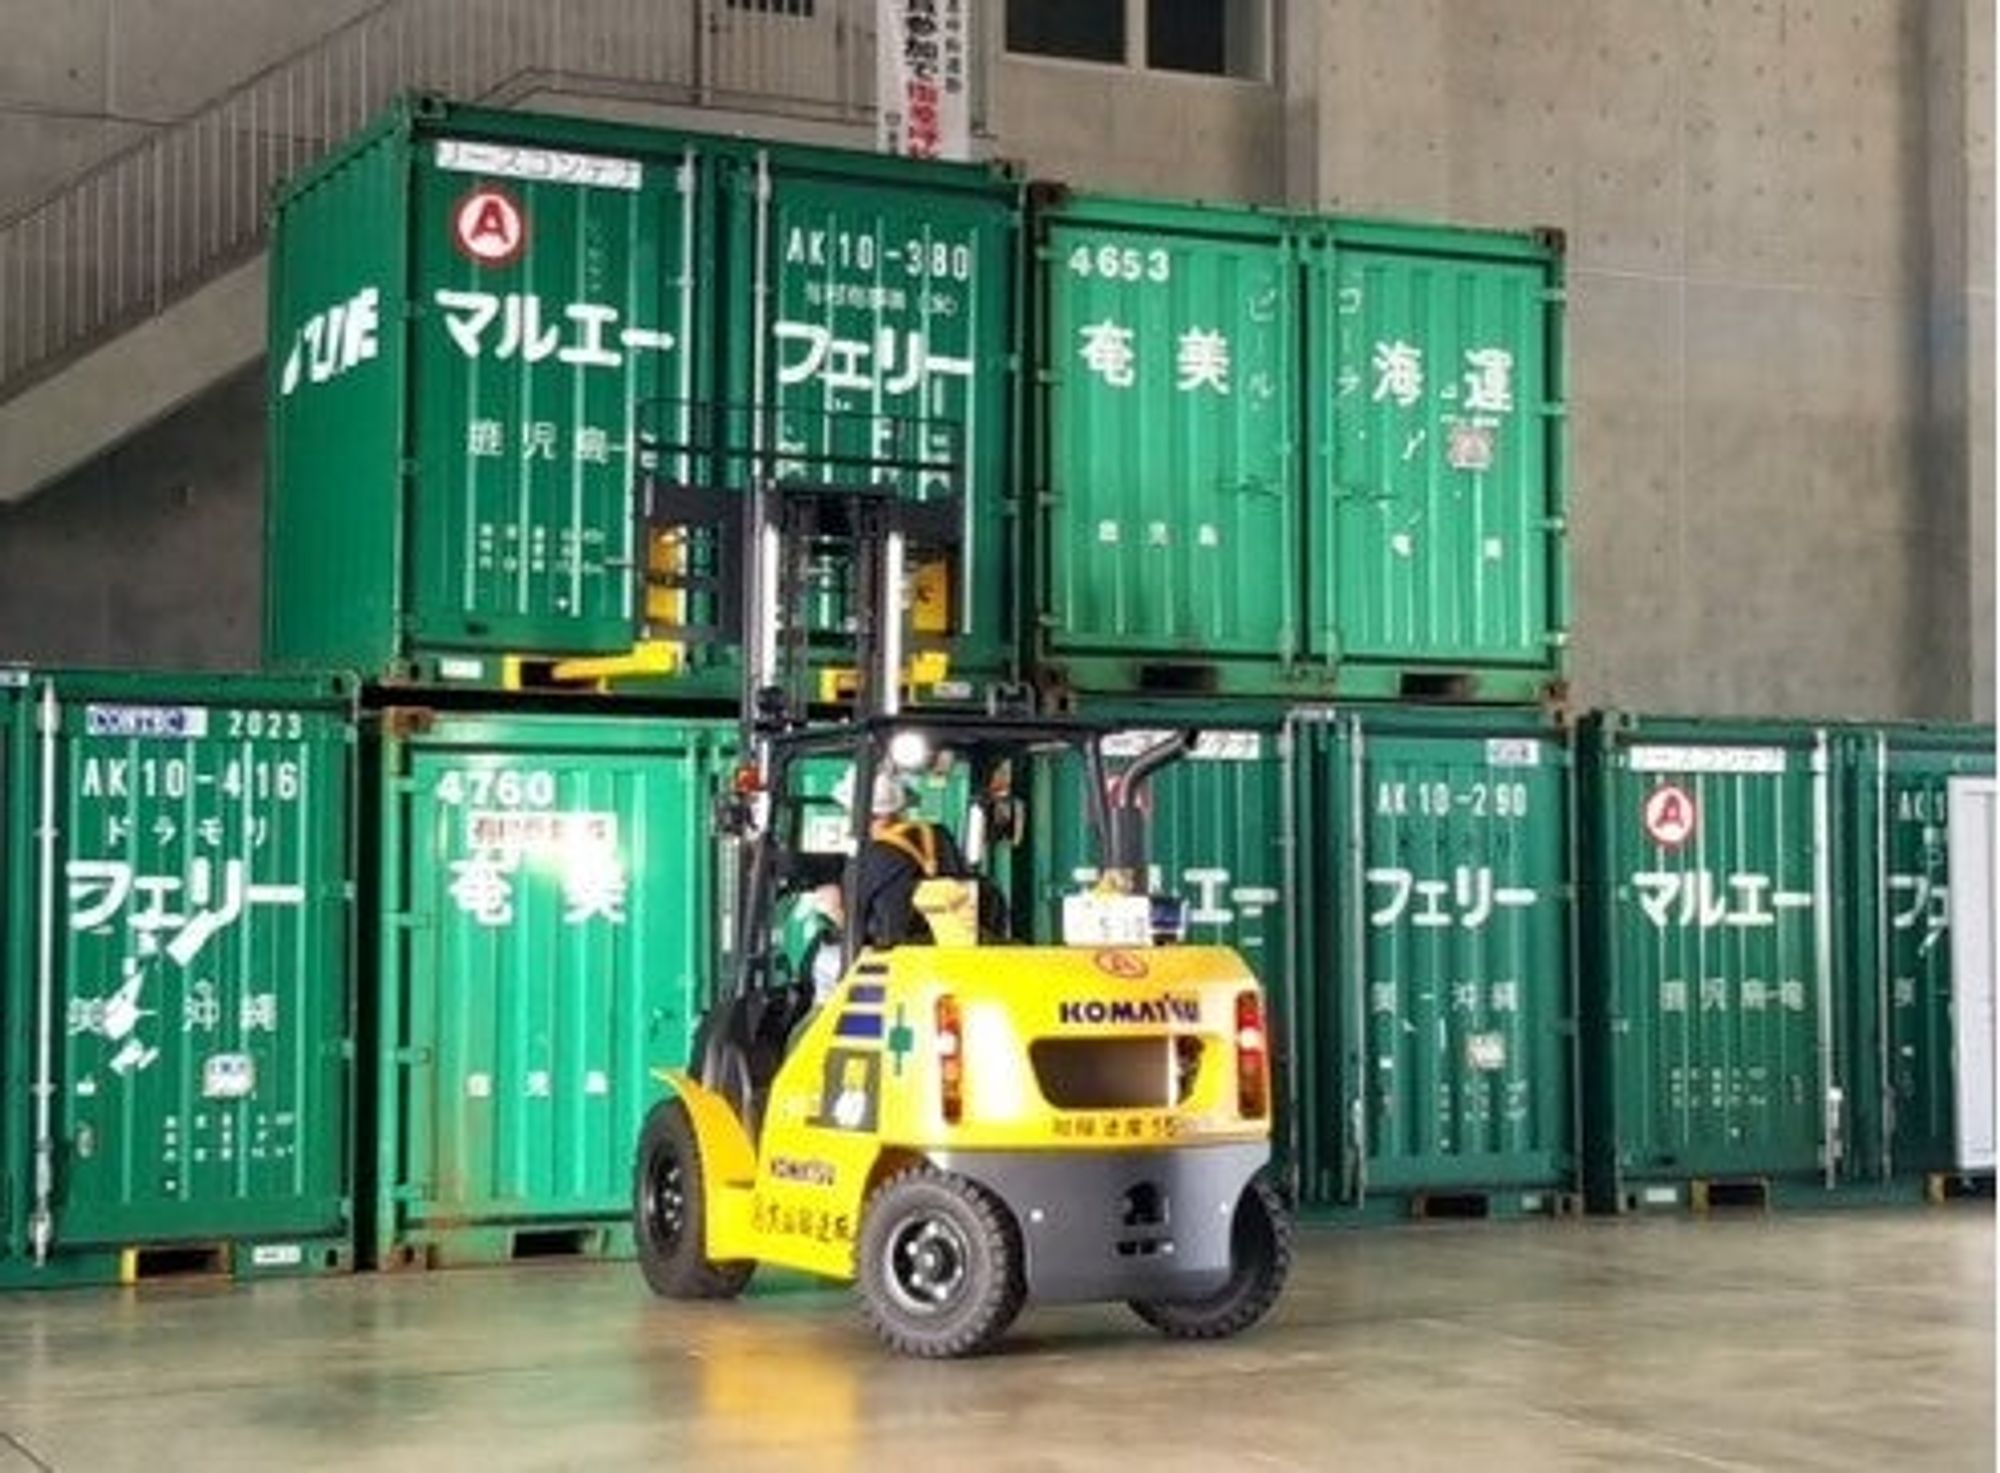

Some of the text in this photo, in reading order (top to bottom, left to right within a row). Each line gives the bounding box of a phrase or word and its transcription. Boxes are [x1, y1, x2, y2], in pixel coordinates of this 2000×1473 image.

[1068, 246, 1170, 282] 4653
[434, 288, 675, 367] マルエー
[773, 320, 974, 394] フェリー
[1371, 338, 1514, 412] 海運
[228, 711, 302, 739] 2023
[436, 769, 556, 806] 4760
[1367, 866, 1537, 928] フェリー
[1632, 870, 1813, 926] マルエー
